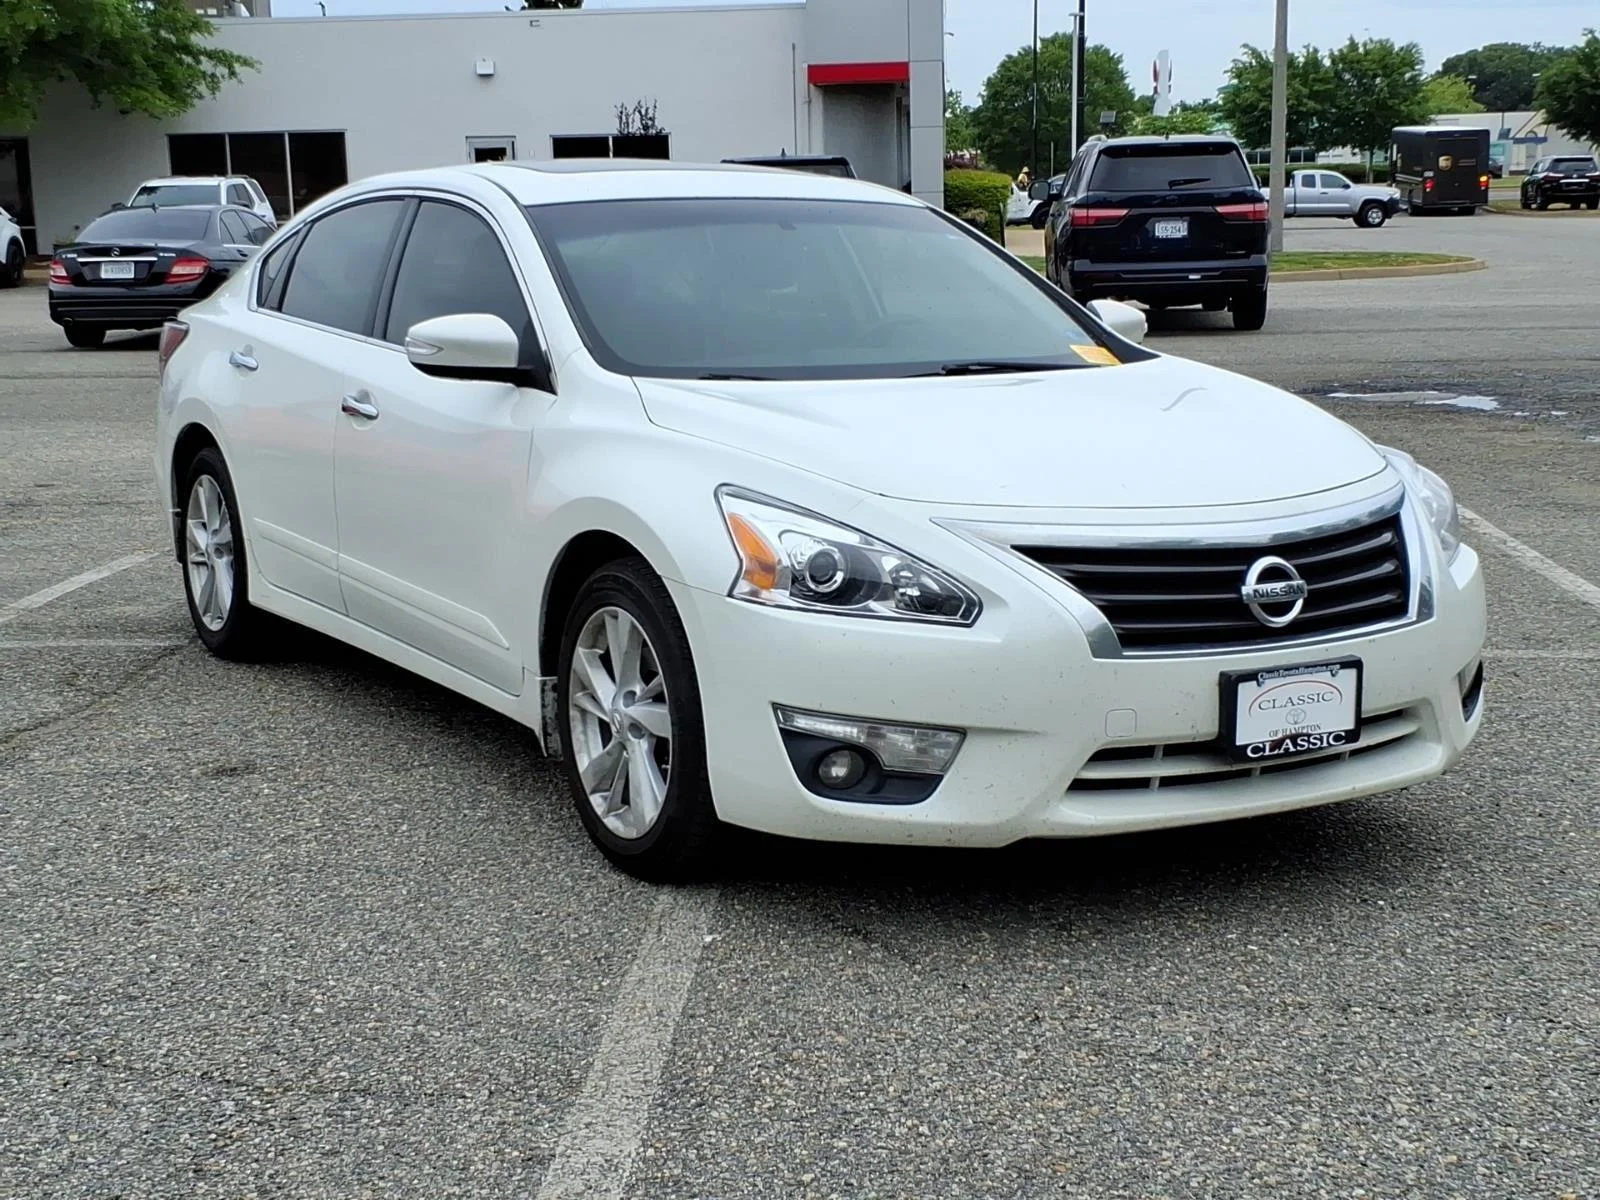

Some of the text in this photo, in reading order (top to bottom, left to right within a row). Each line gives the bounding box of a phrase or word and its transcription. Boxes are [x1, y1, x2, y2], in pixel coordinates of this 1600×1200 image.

[1253, 582, 1304, 599] NISSAN
[1258, 691, 1334, 711] CLASSIC
[1268, 723, 1322, 738] OF HAMPTON
[1246, 731, 1346, 758] CLASSIC
